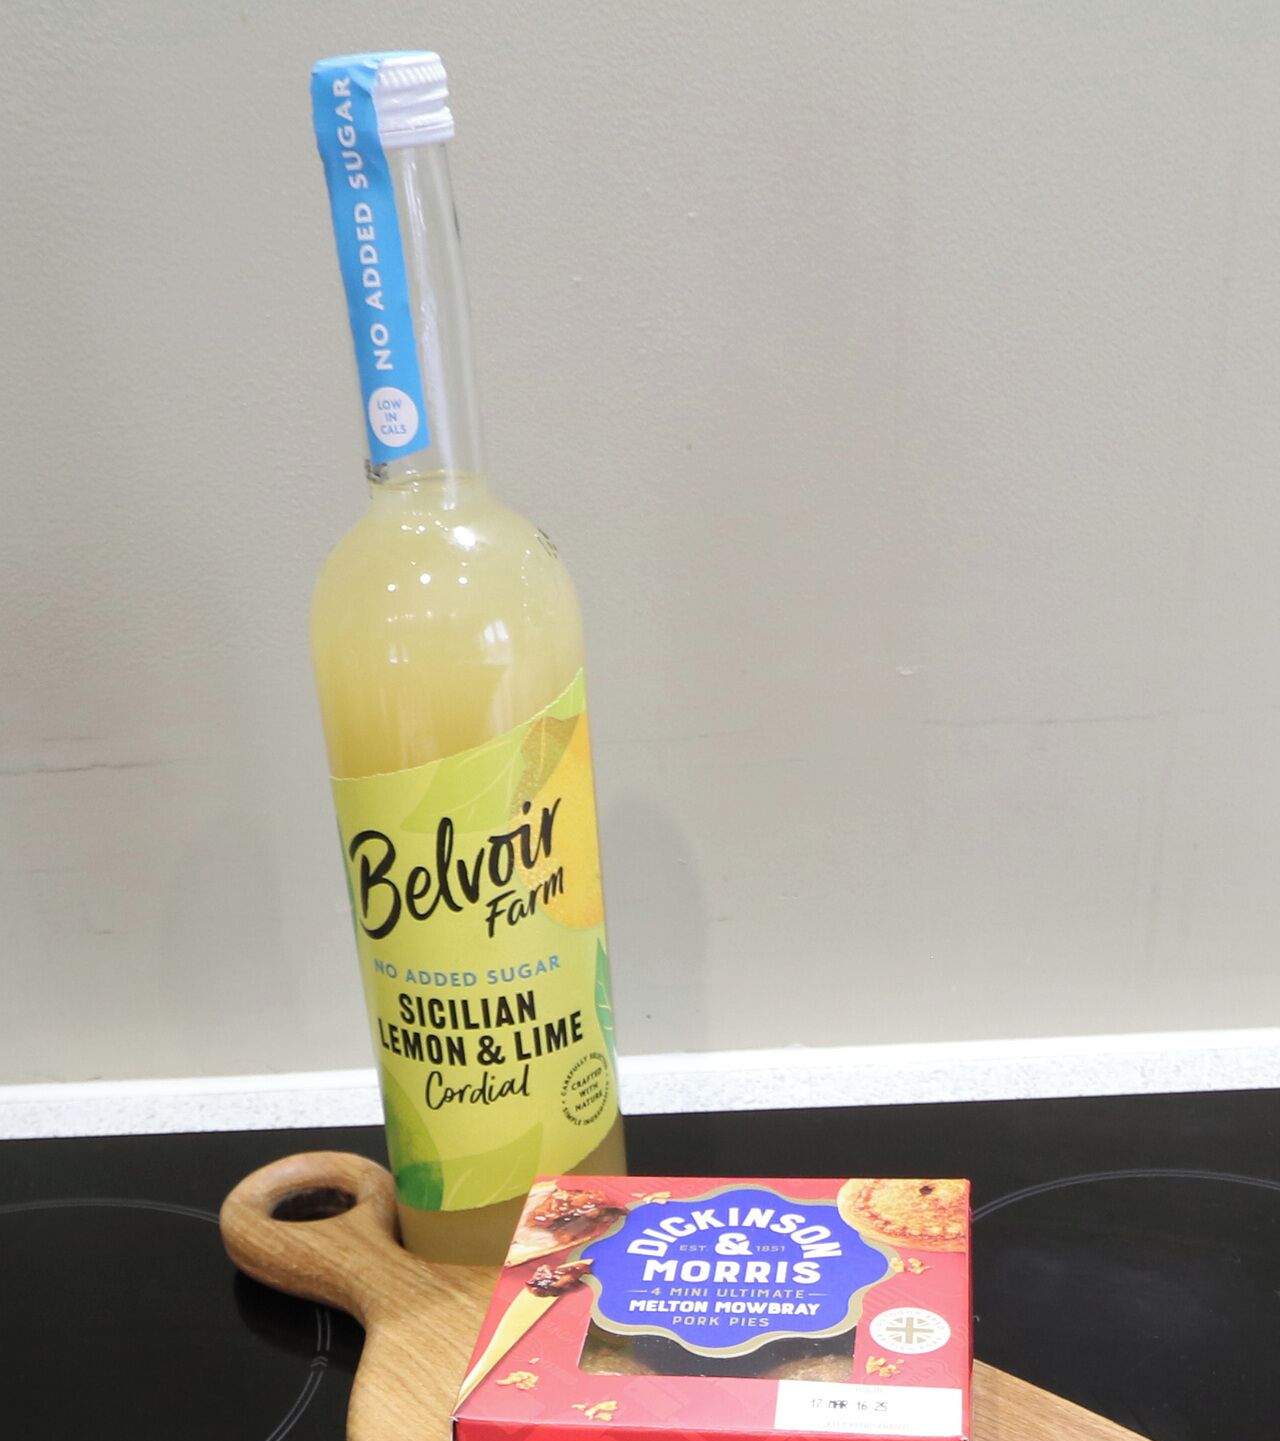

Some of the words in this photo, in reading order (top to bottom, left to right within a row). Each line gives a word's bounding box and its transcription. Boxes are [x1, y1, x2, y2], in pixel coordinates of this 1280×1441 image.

[333, 75, 368, 190] SUGAR
[354, 202, 385, 311] ADDED
[371, 322, 394, 371] NO
[377, 400, 401, 410] LOW
[385, 412, 397, 421] IN
[380, 424, 407, 435] CALS
[349, 797, 562, 940] Belvoir
[485, 866, 564, 938] Farm
[374, 958, 398, 979] NO
[405, 968, 478, 987] ADDED
[487, 955, 561, 985] SUGAR
[397, 990, 538, 1030] SICILIAN
[377, 1018, 467, 1066] LEMON
[476, 1035, 506, 1066] &
[514, 1010, 584, 1062] LIME
[425, 1064, 531, 1111] Cordial
[575, 1090, 602, 1112] NATURE
[626, 1207, 842, 1259] DICKINSON
[714, 1232, 753, 1256] &
[756, 1244, 785, 1252] 1851
[642, 1259, 821, 1284] MORRIS
[629, 1299, 709, 1313] MELTON
[714, 1301, 820, 1316] MOWBRAY
[650, 1287, 661, 1296] 4
[670, 1288, 708, 1297] MINI
[716, 1288, 805, 1299] ULTIMATE
[672, 1316, 719, 1326] PORK
[729, 1317, 770, 1327] PIES
